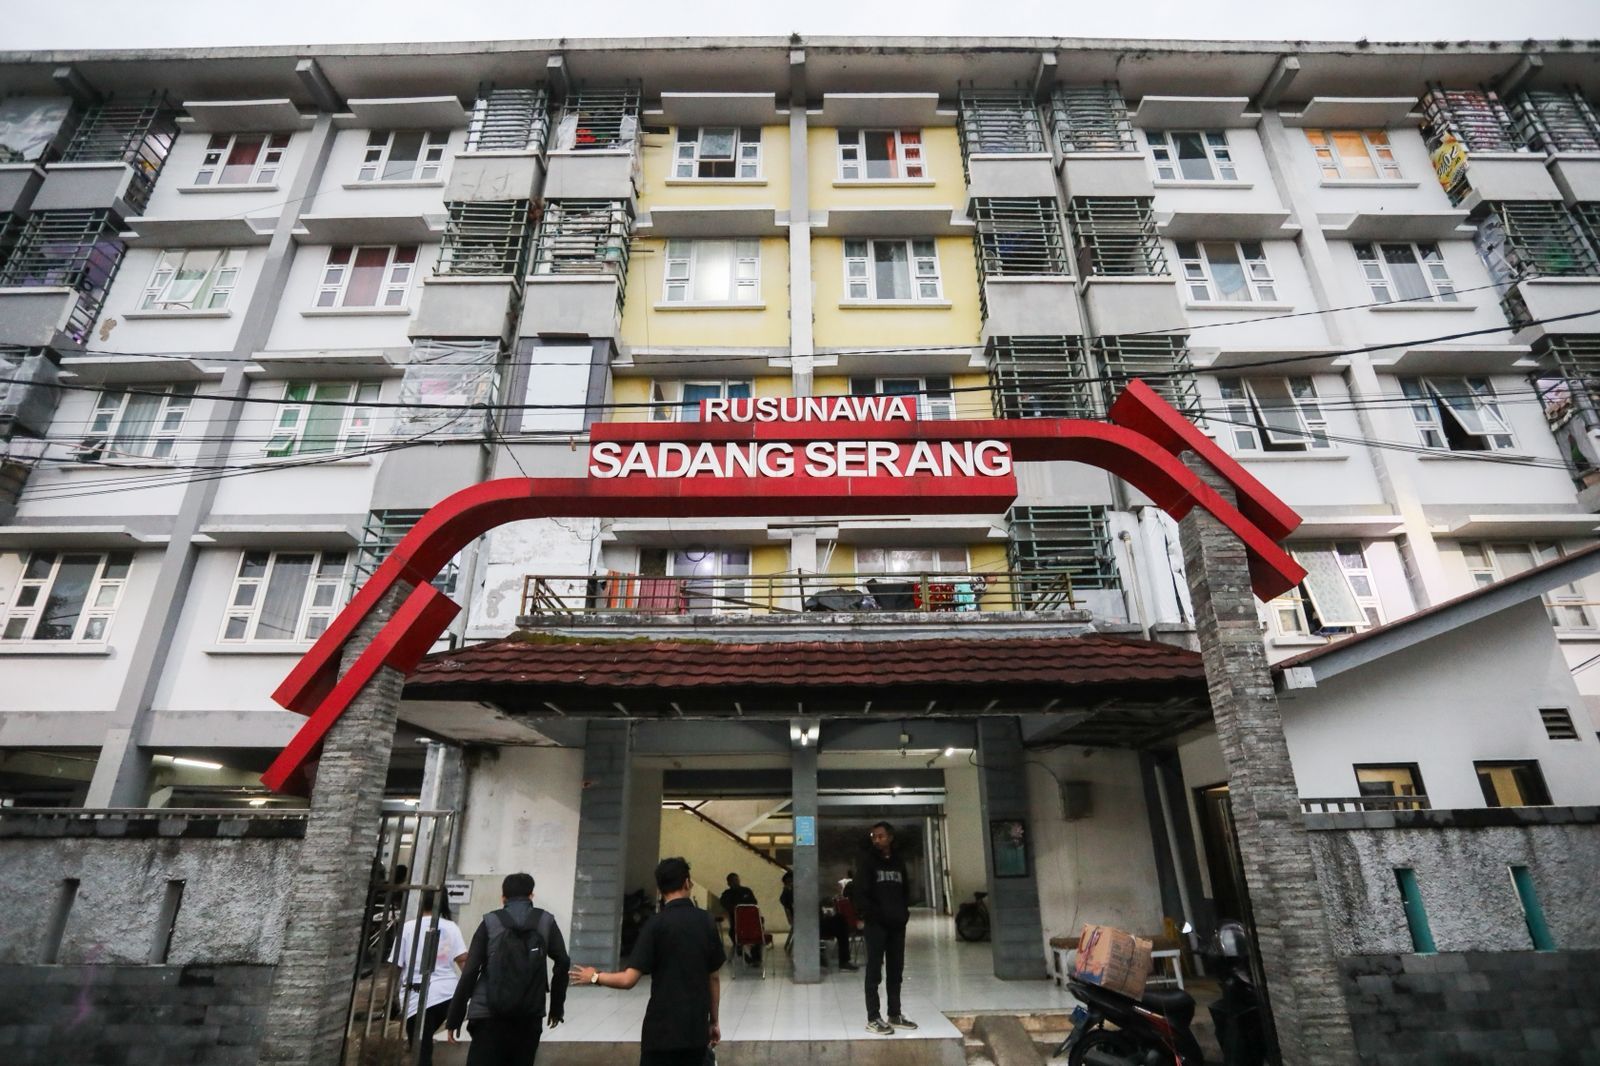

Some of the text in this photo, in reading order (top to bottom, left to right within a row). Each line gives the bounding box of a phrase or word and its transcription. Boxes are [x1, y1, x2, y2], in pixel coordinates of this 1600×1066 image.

[704, 396, 911, 423] RUSUNAWA
[589, 440, 1012, 479] SADANG SERANG
